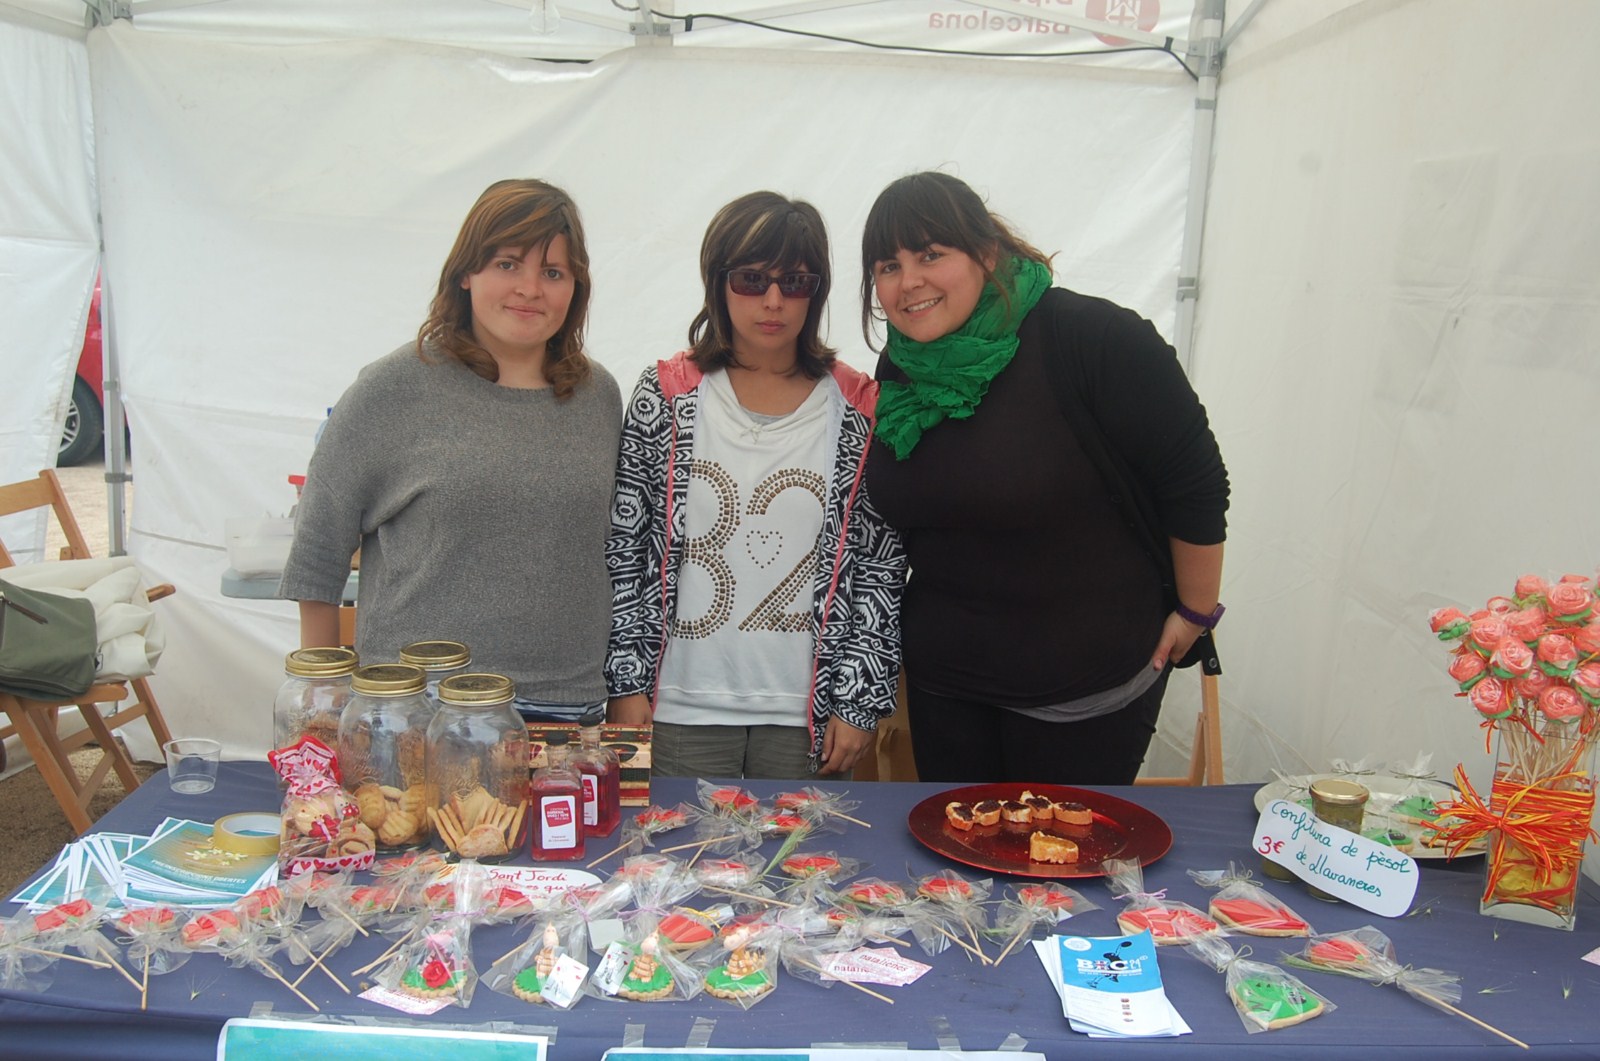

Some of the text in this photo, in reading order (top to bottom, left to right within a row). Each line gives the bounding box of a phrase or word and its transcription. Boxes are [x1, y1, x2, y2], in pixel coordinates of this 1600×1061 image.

[1271, 801, 1332, 847] Confitura
[1340, 838, 1358, 857] de
[1258, 836, 1285, 855] 3€
[1295, 844, 1308, 866] de
[489, 868, 568, 883] Sant Jordi
